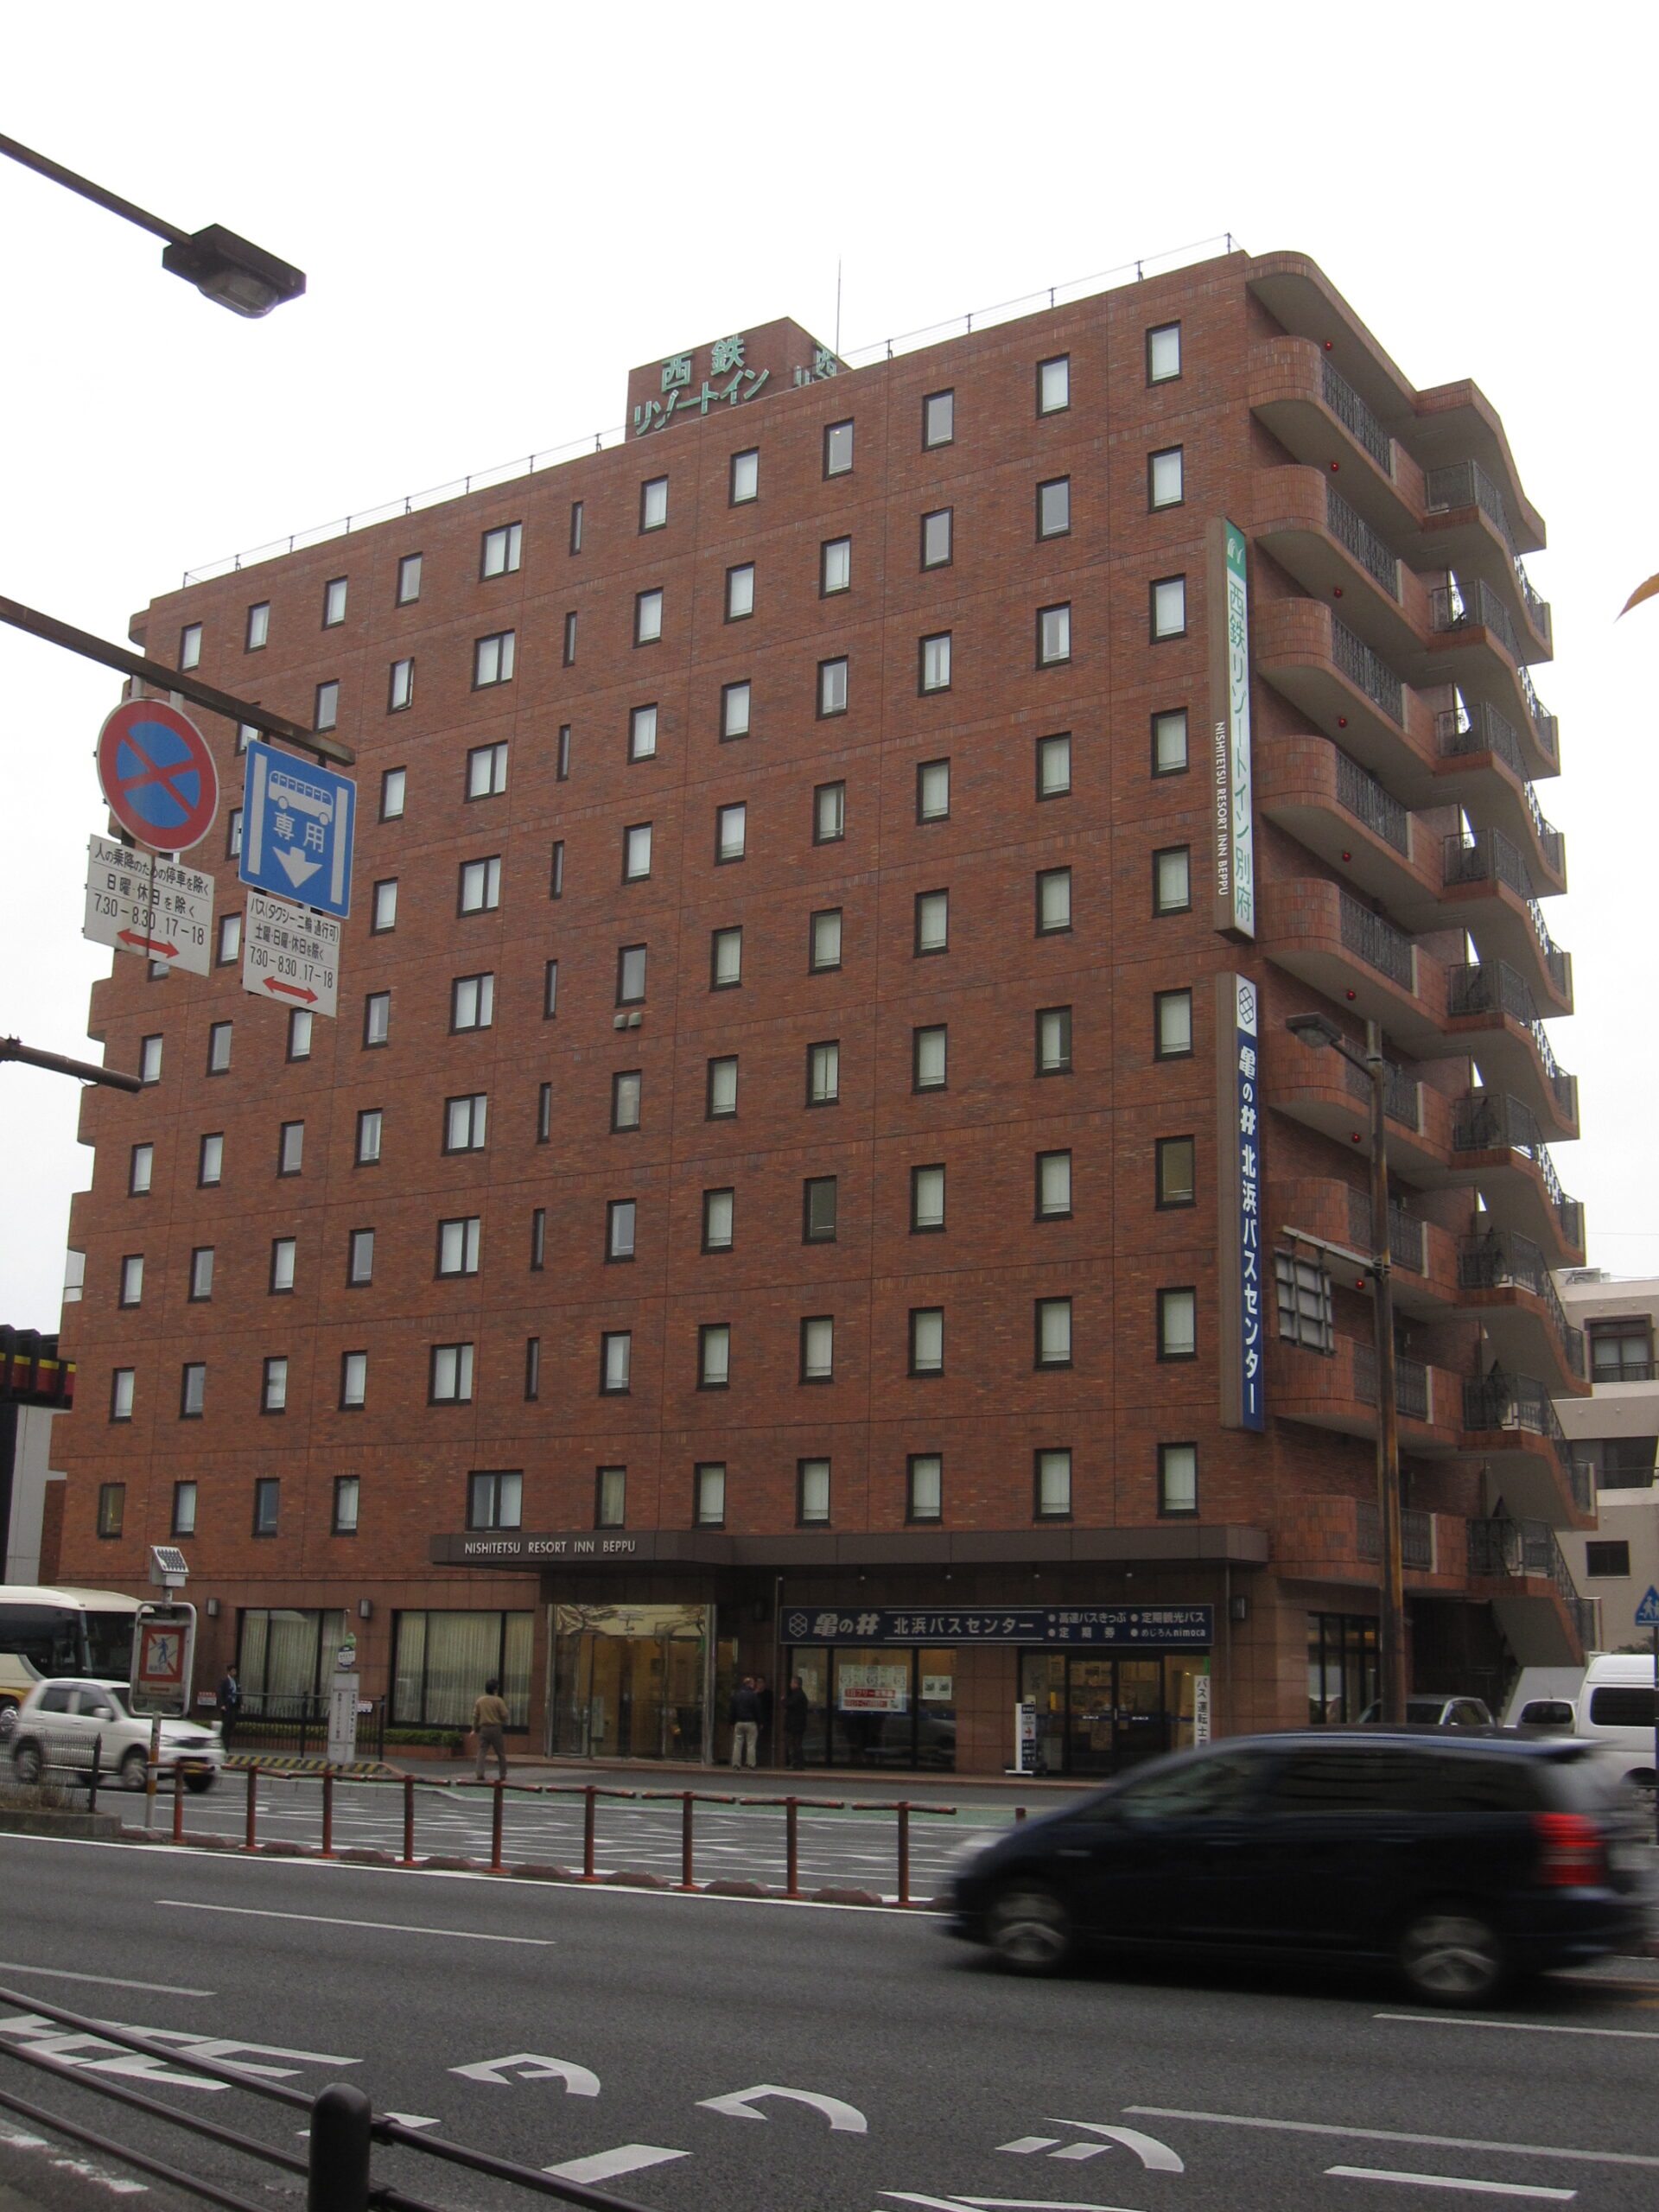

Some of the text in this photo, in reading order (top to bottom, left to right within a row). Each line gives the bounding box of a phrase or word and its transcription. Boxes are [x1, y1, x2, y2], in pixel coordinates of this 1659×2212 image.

[660, 334, 746, 391] 西鉄
[633, 369, 769, 435] リゾートイン
[1230, 580, 1251, 923] 西鉄リゾートイン別府
[273, 811, 325, 854] 専用
[1215, 721, 1229, 896] NISHITETSU RESORT INN BEPPU
[94, 842, 209, 896] 人の乗降のための停車を除く
[1239, 1045, 1259, 1414] 亀の井 北浜バスセンター
[465, 1540, 636, 1554] NISHITETSU RESORT INN BEPPU
[812, 1612, 1034, 1637] 亀の井 北浜バスセンター
